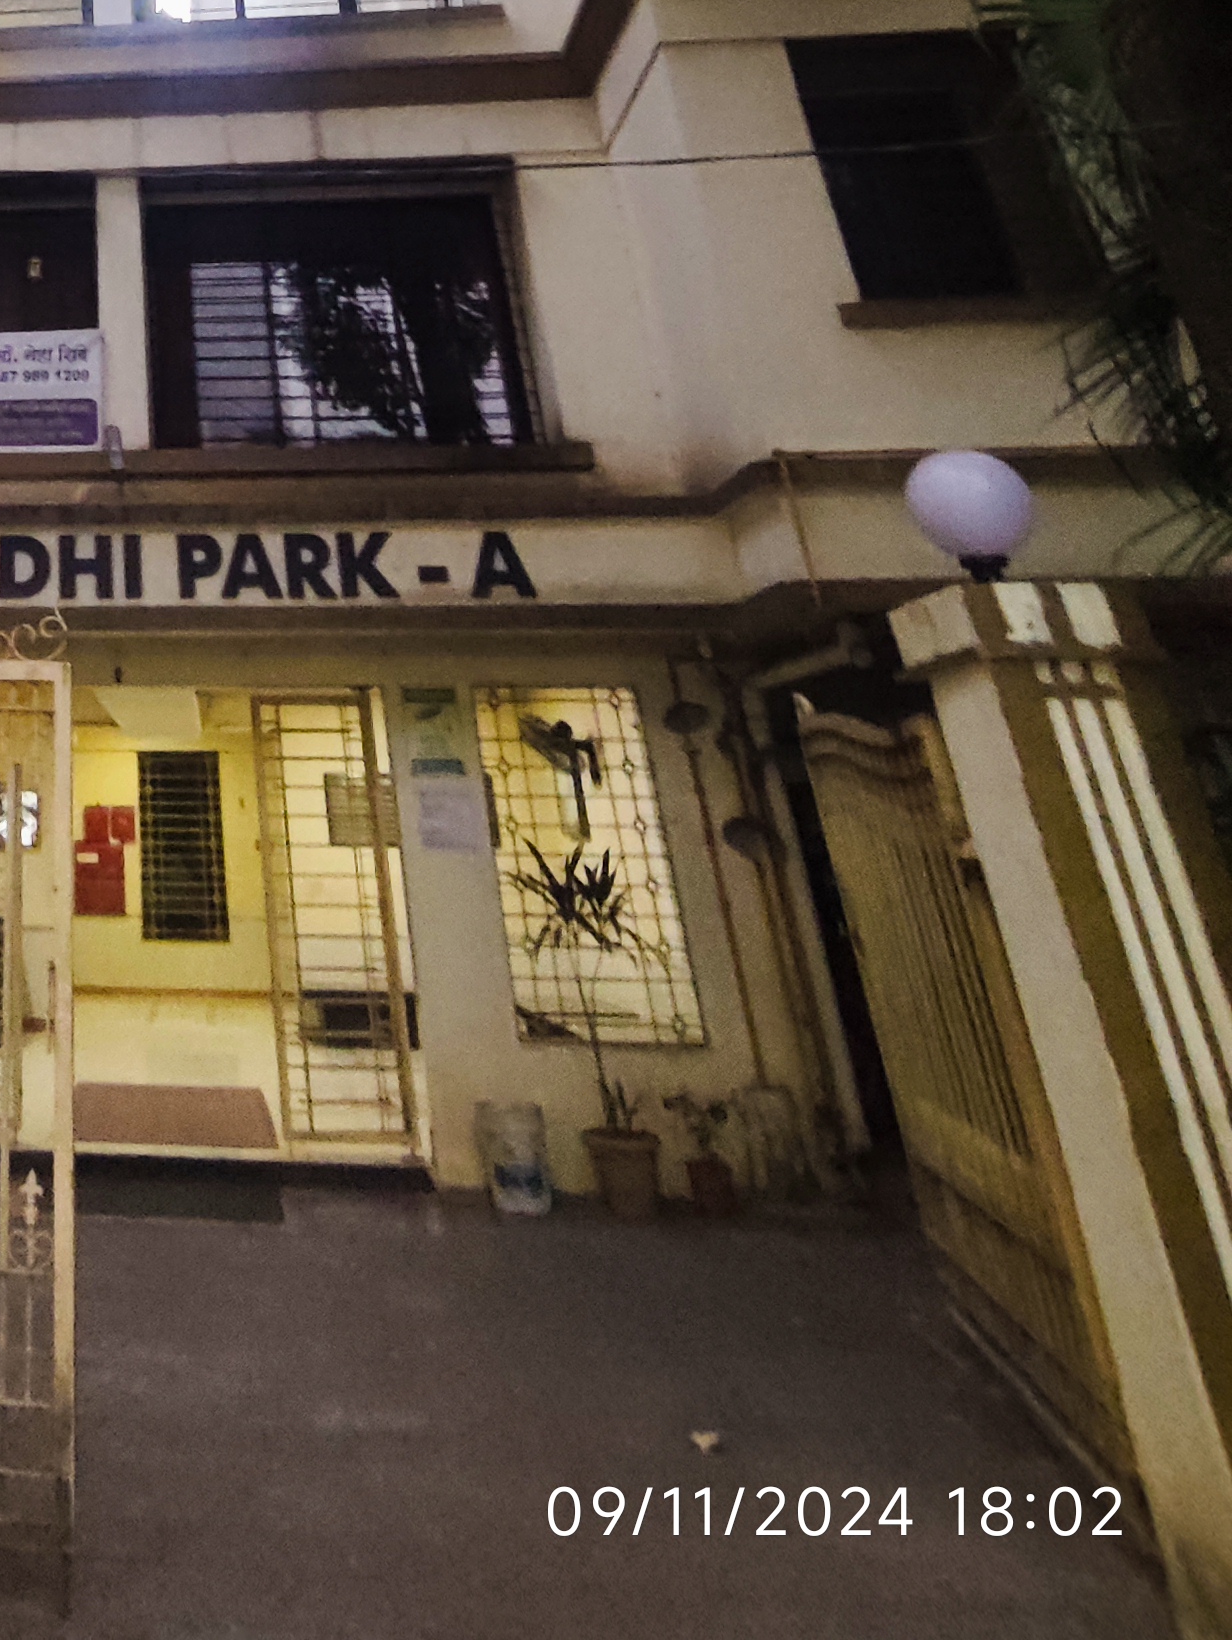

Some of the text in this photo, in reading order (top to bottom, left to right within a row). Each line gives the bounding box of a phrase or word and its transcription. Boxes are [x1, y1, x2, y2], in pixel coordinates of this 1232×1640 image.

[176, 531, 401, 600] PARK
[418, 565, 450, 583] -
[472, 531, 538, 599] A
